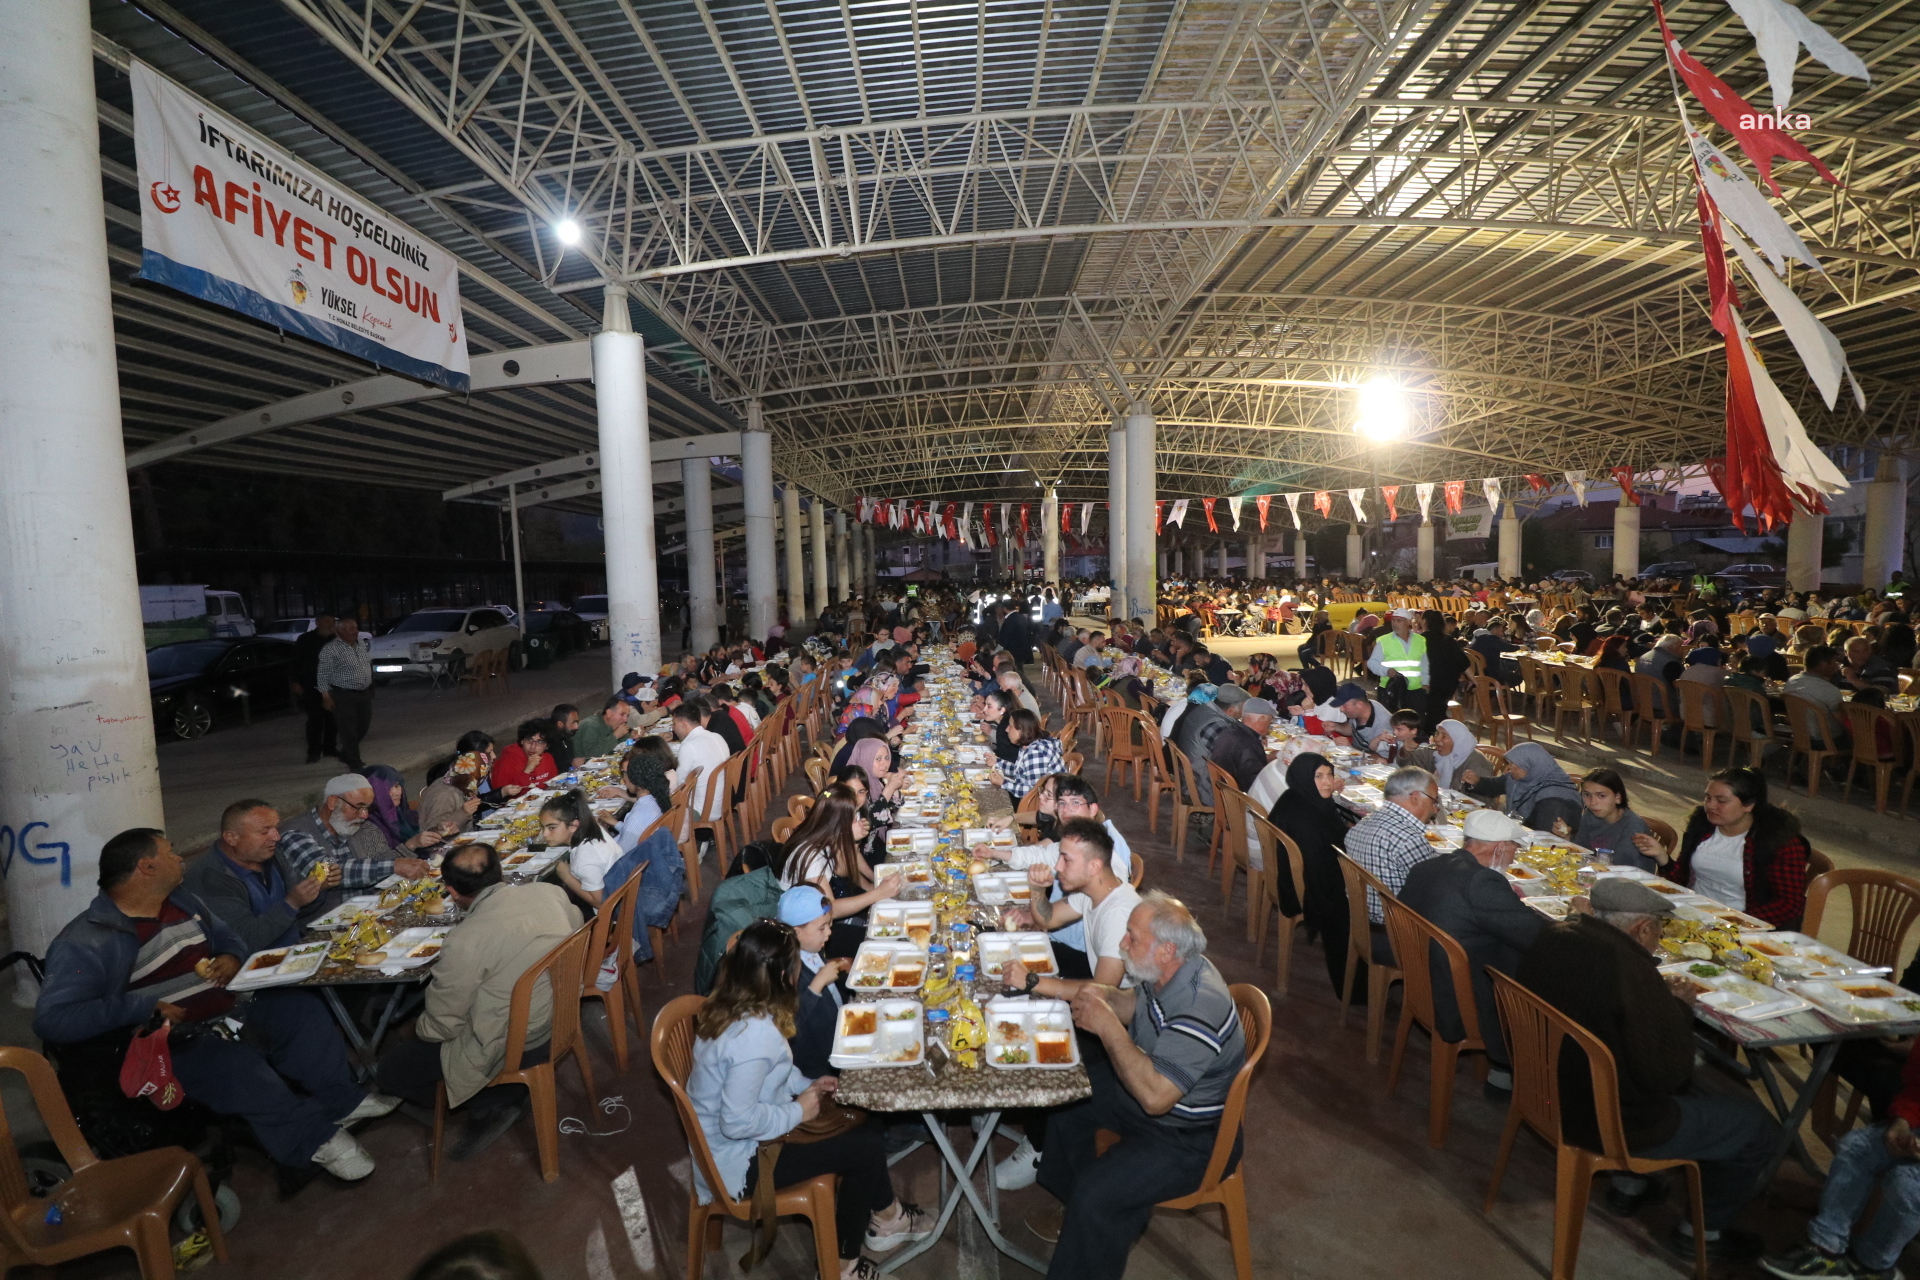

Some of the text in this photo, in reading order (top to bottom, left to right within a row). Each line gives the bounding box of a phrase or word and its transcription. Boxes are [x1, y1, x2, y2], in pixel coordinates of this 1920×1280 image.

[193, 164, 441, 323] AFİYET OLSUN
[198, 112, 430, 272] İFTARIMIZA HOŞGELDİNİZ
[321, 286, 358, 319] YÜKSEL
[362, 306, 394, 330] Kepenek
